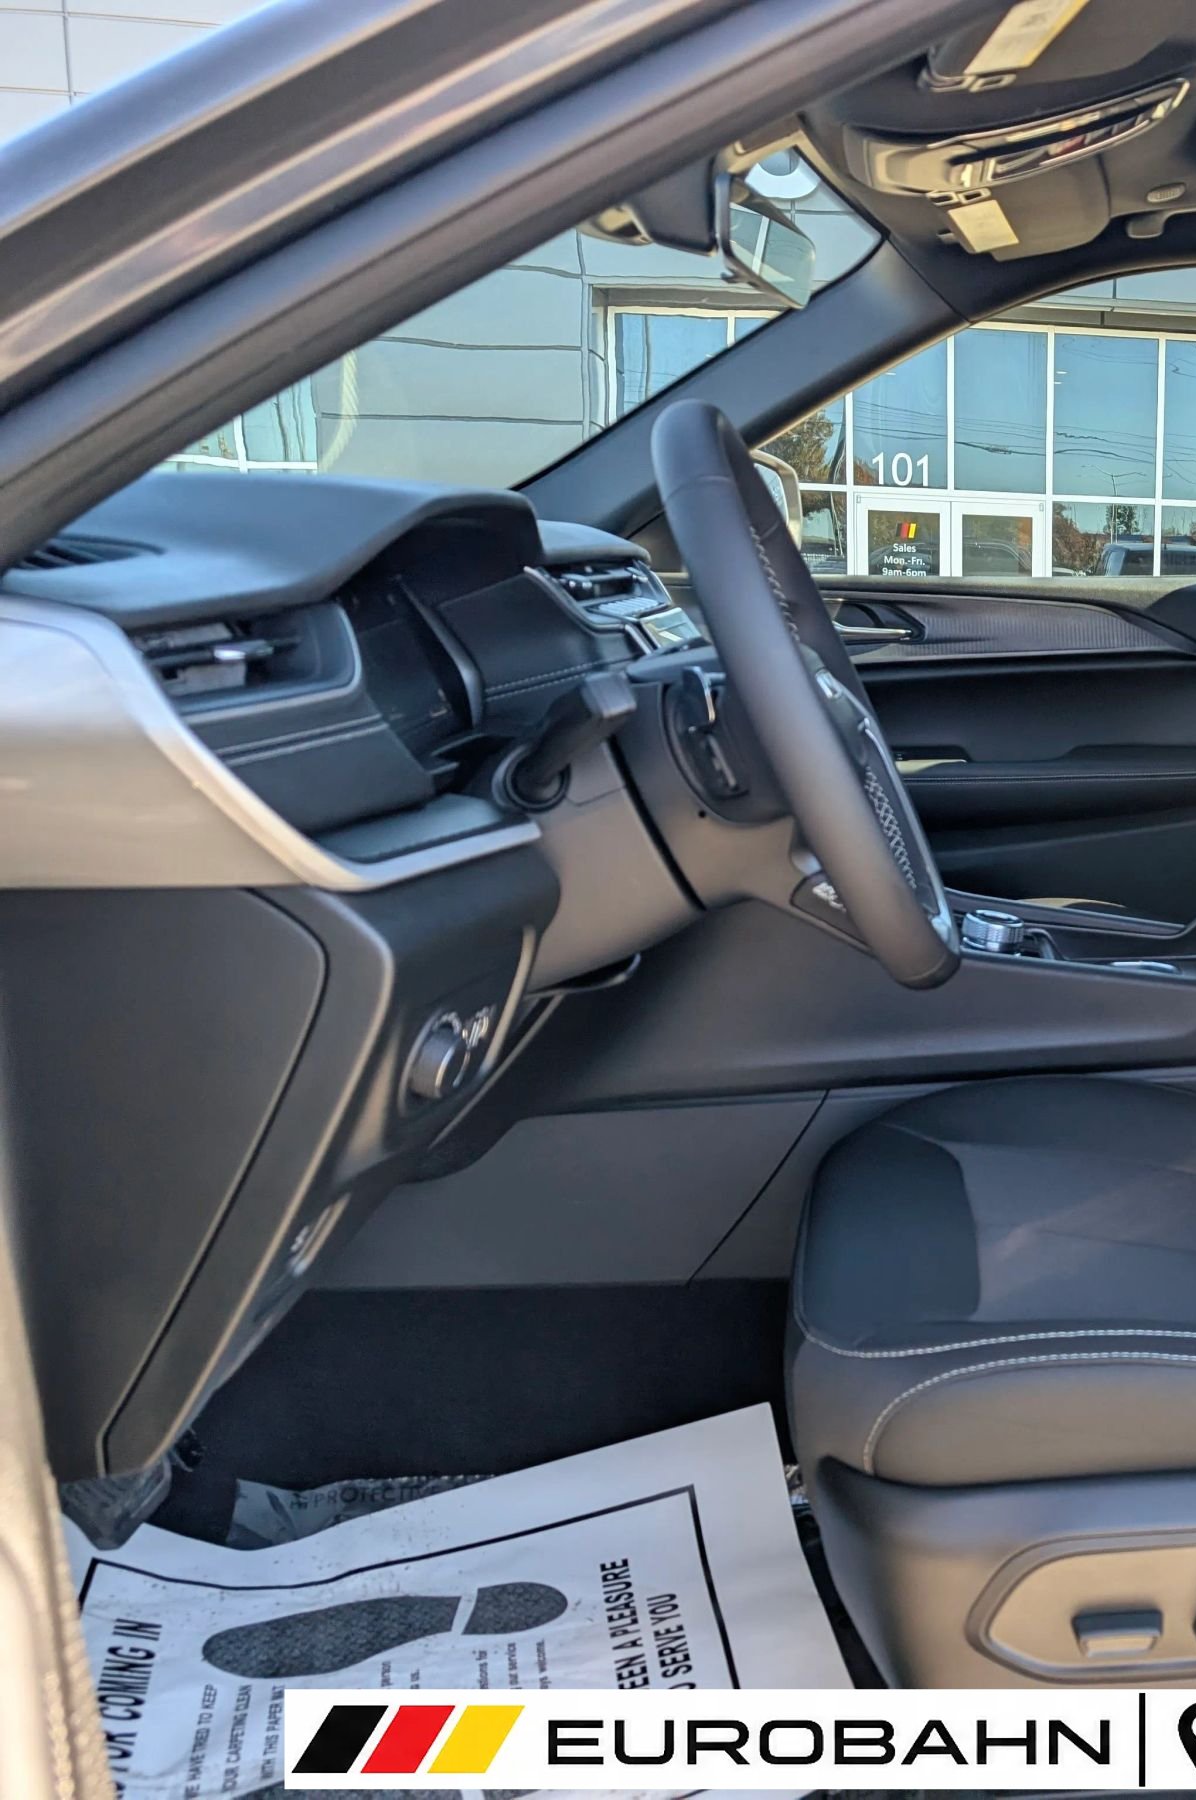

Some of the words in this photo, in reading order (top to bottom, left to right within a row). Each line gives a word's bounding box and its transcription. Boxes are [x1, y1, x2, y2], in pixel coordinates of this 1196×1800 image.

[872, 451, 929, 487] 101
[883, 556, 925, 566] Mon.-Fri.
[893, 543, 917, 553] Sales
[600, 1558, 641, 1638] PLEASURE
[646, 1593, 681, 1626] YOU
[112, 1618, 162, 1642] IN
[612, 1637, 644, 1651] A
[654, 1624, 693, 1678] SERVE
[97, 1645, 156, 1721] COMING
[201, 1684, 217, 1709] KEEP
[266, 1703, 283, 1732] PAPER
